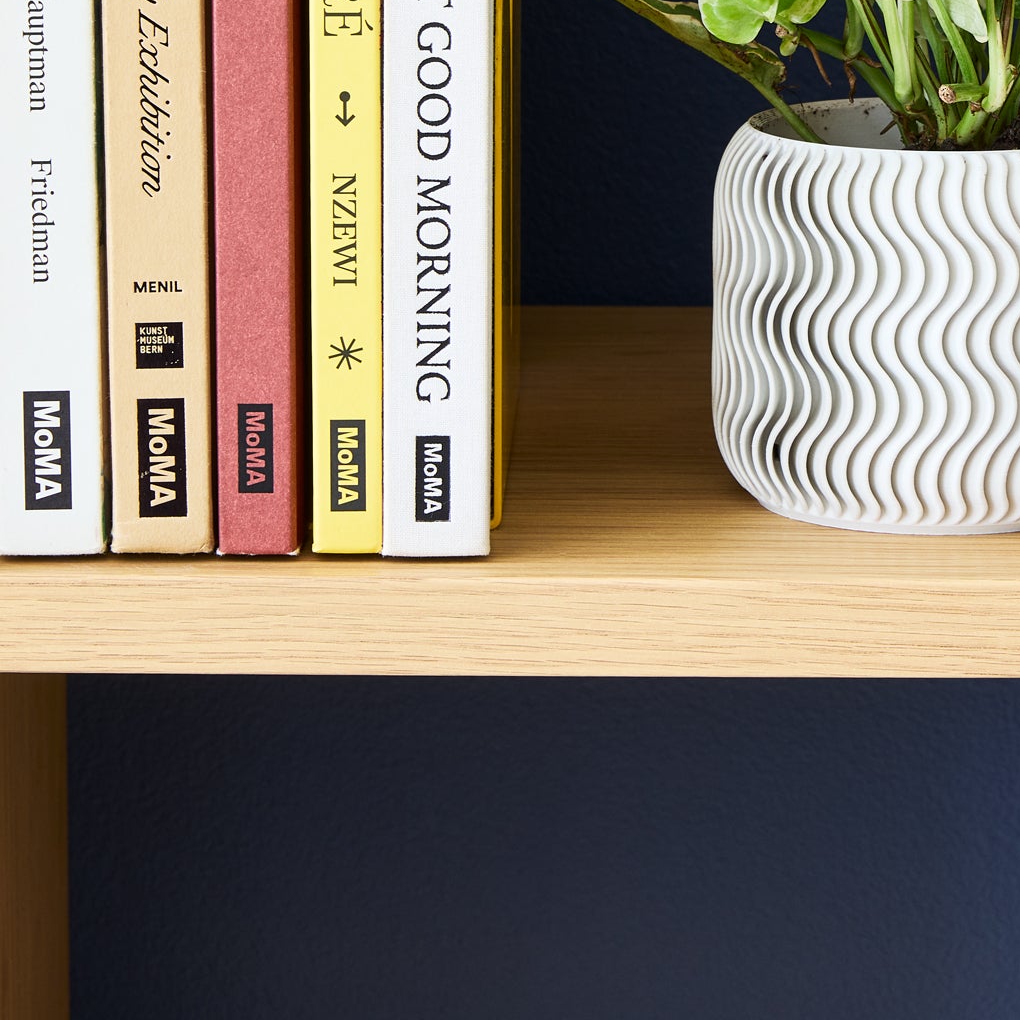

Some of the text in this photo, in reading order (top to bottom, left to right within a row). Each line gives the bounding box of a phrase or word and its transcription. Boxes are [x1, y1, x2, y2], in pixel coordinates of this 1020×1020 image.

[138, 9, 171, 197] Exhibition
[417, 22, 452, 160] GOOD
[31, 159, 55, 283] Friedman
[333, 173, 357, 286] NZEWI
[134, 281, 182, 293] MENIL
[416, 175, 451, 403] MORNING
[140, 327, 167, 336] KUNST
[140, 336, 174, 344] MUSEUM
[140, 345, 162, 353] BERN
[34, 401, 61, 499] MoMA
[148, 409, 176, 506] MoMA
[246, 412, 265, 485] MoMA
[338, 428, 358, 504] MoMA
[424, 444, 442, 514] MoMA
